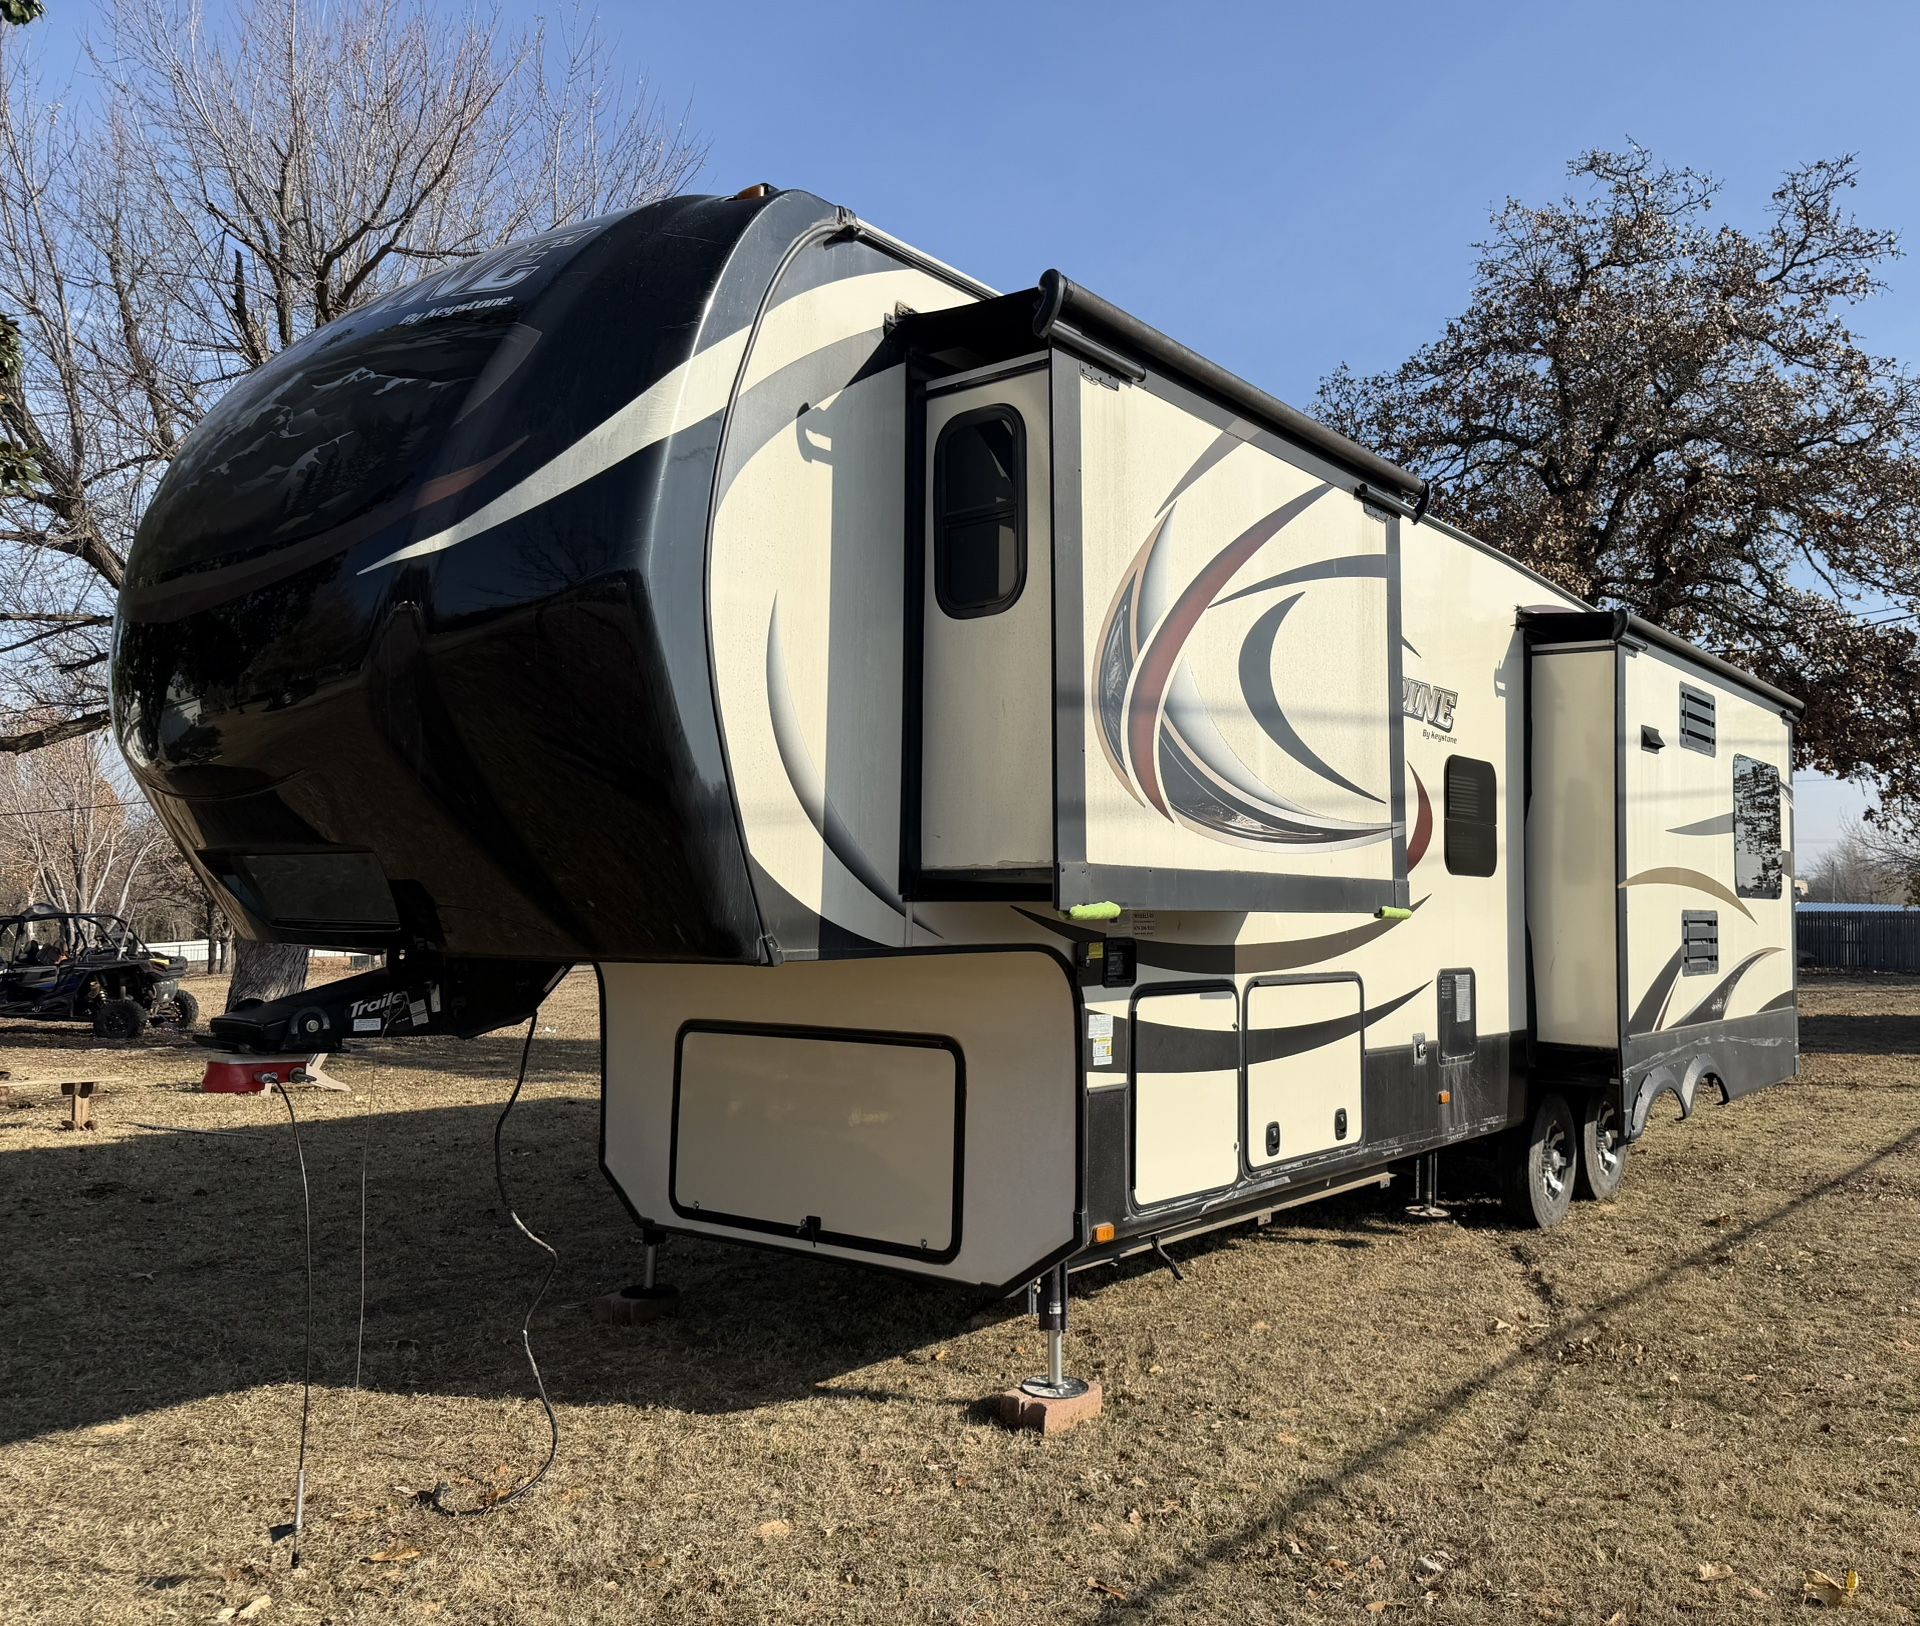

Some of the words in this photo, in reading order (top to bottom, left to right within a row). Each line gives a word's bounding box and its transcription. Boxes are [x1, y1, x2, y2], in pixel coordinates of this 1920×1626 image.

[398, 312, 425, 326] By
[423, 296, 514, 319] Keystone
[1403, 677, 1458, 733] INE
[1422, 729, 1431, 740] By
[1431, 731, 1457, 744] Keystone
